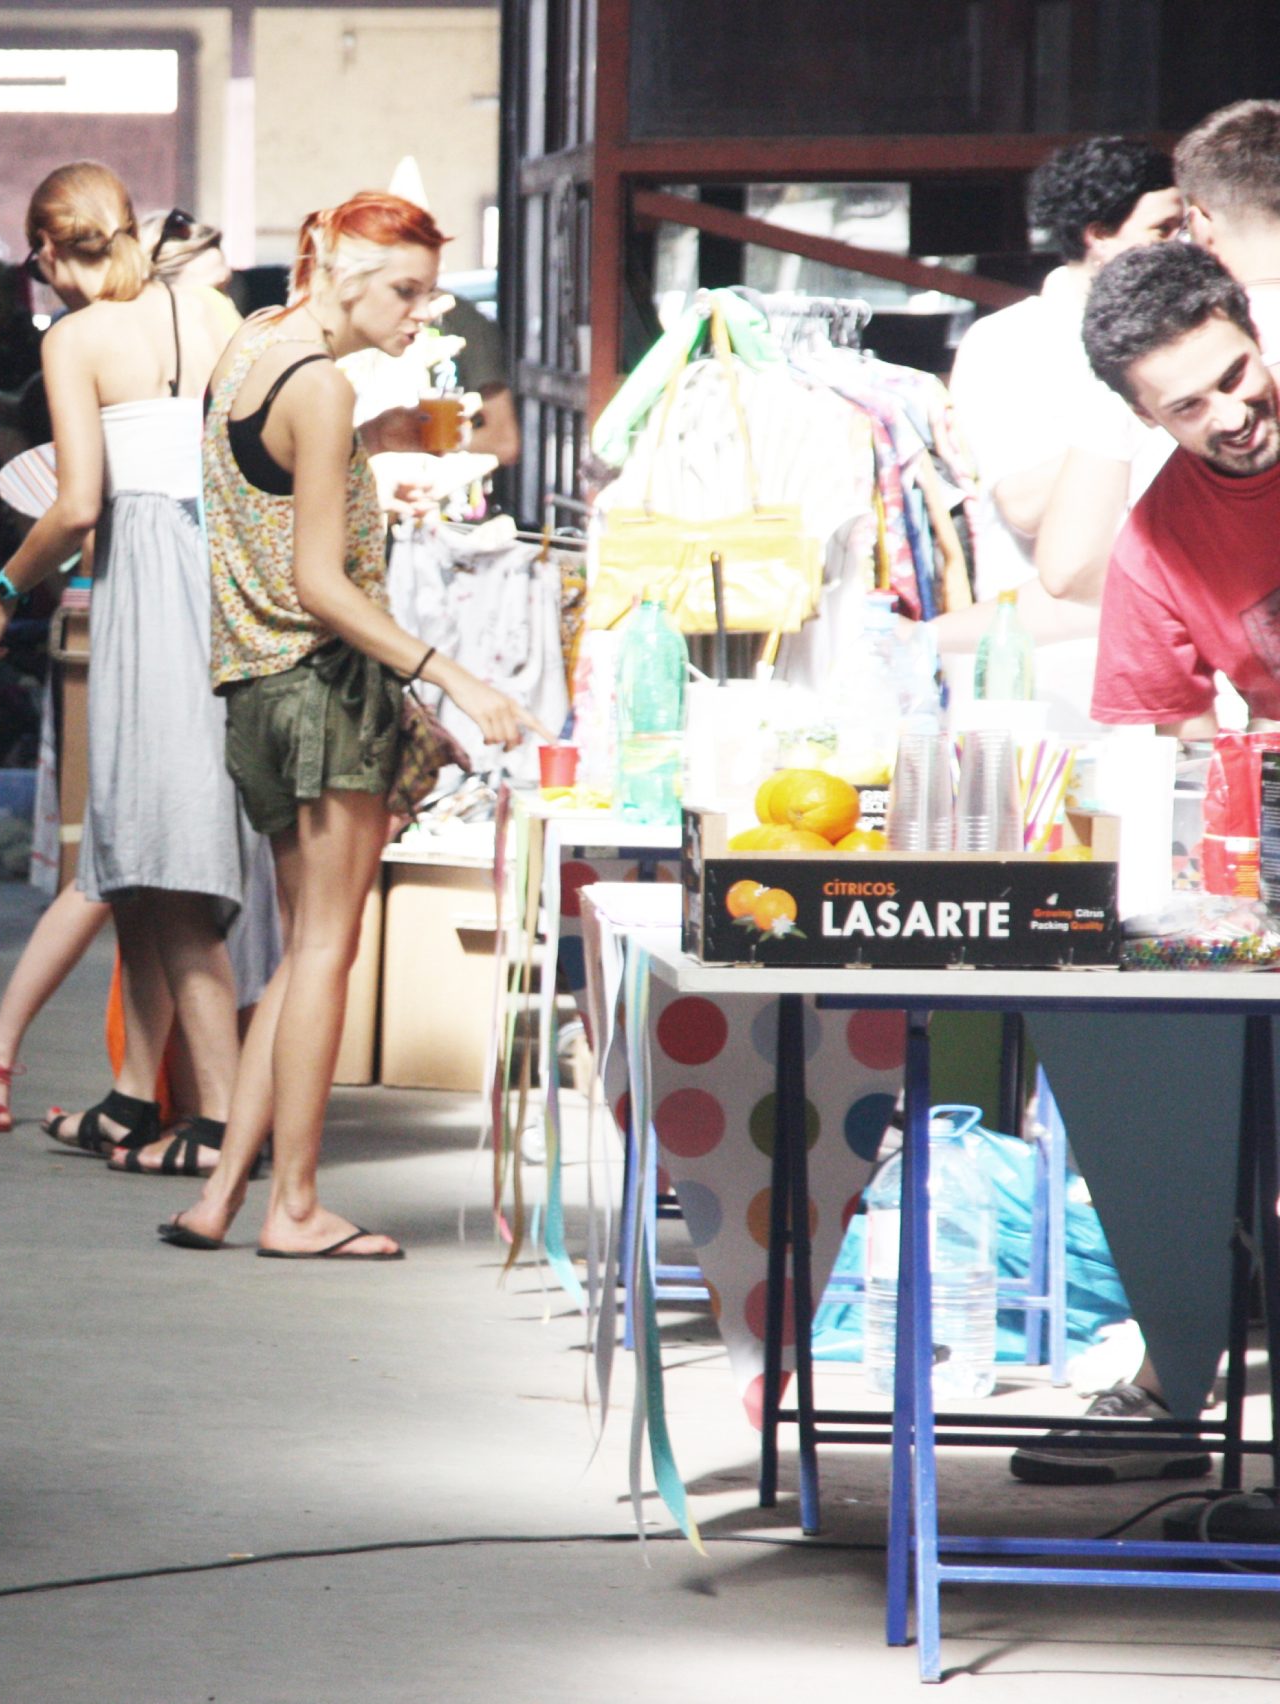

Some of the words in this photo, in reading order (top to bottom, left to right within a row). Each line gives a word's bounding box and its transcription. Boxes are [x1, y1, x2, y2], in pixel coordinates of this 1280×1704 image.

[823, 879, 896, 896] CÍTRICOS
[822, 900, 1010, 937] LASARTE
[1075, 908, 1105, 918] Citrus
[1030, 920, 1069, 931] Packing
